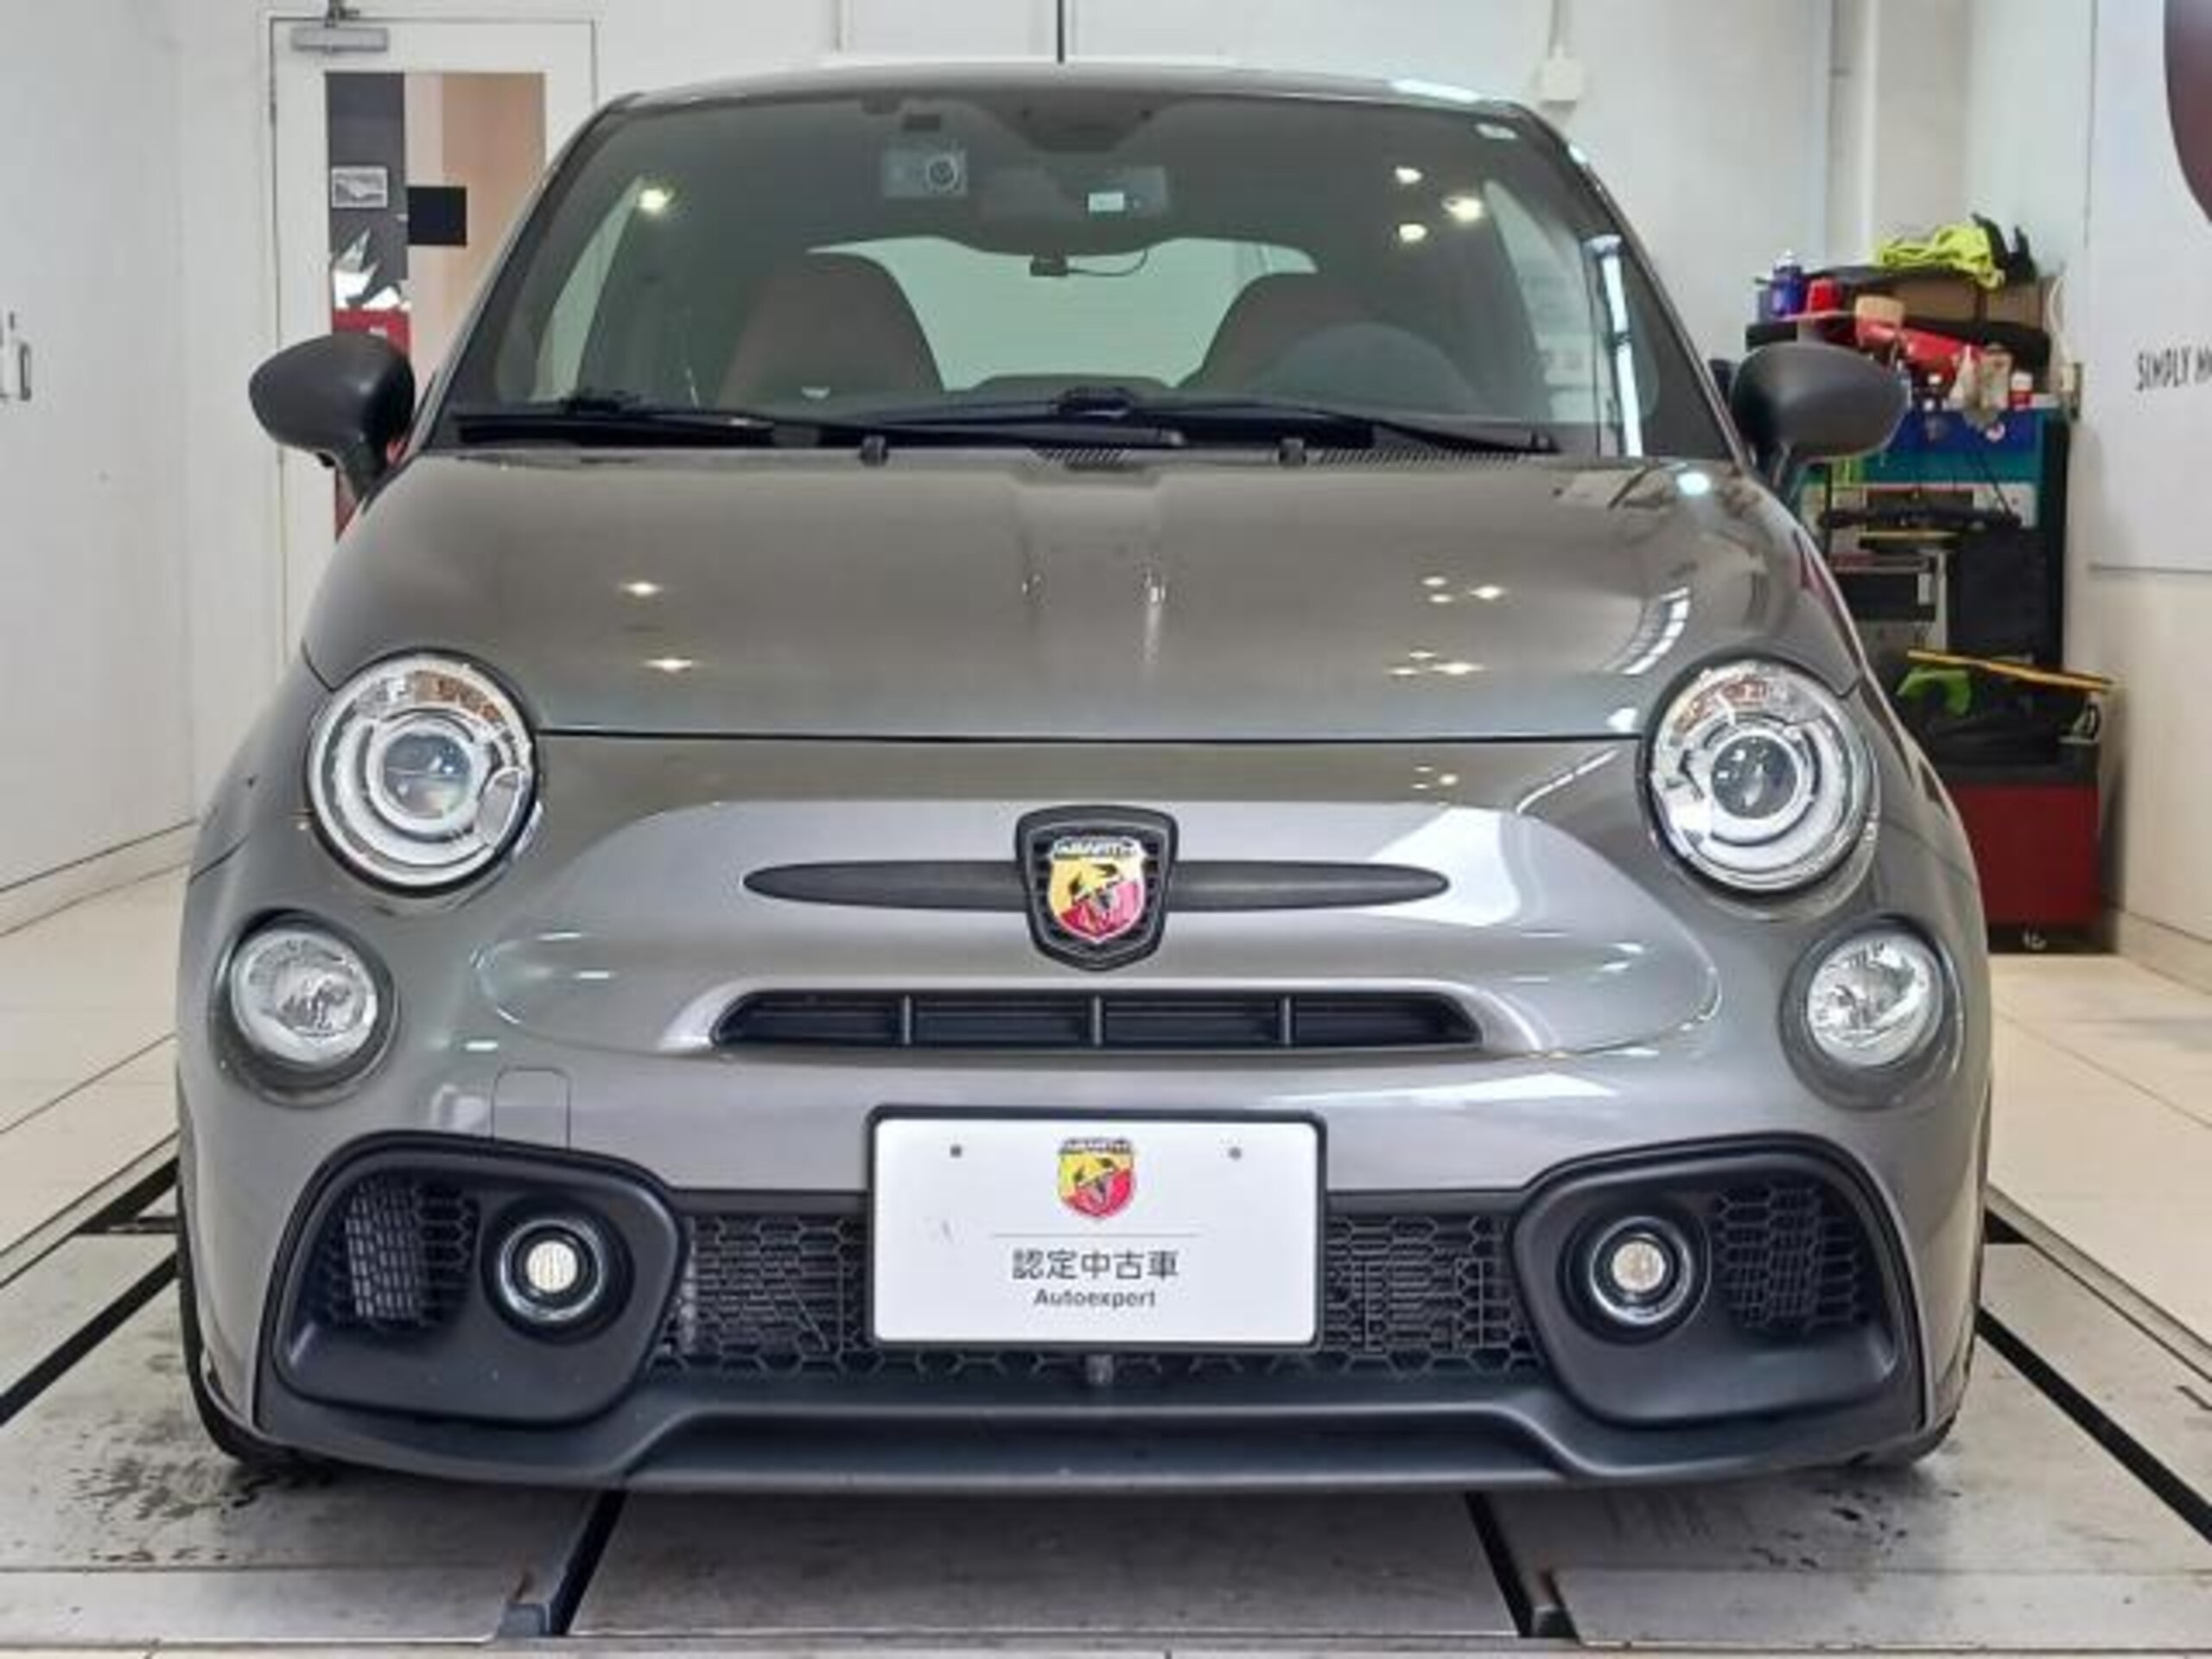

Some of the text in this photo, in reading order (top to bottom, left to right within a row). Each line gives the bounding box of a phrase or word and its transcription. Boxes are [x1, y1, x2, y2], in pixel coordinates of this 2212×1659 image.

[2136, 348, 2192, 392] SIMPLY
[1011, 1249, 1179, 1281] 認定中古車
[1033, 1288, 1156, 1309] Autoexpert
